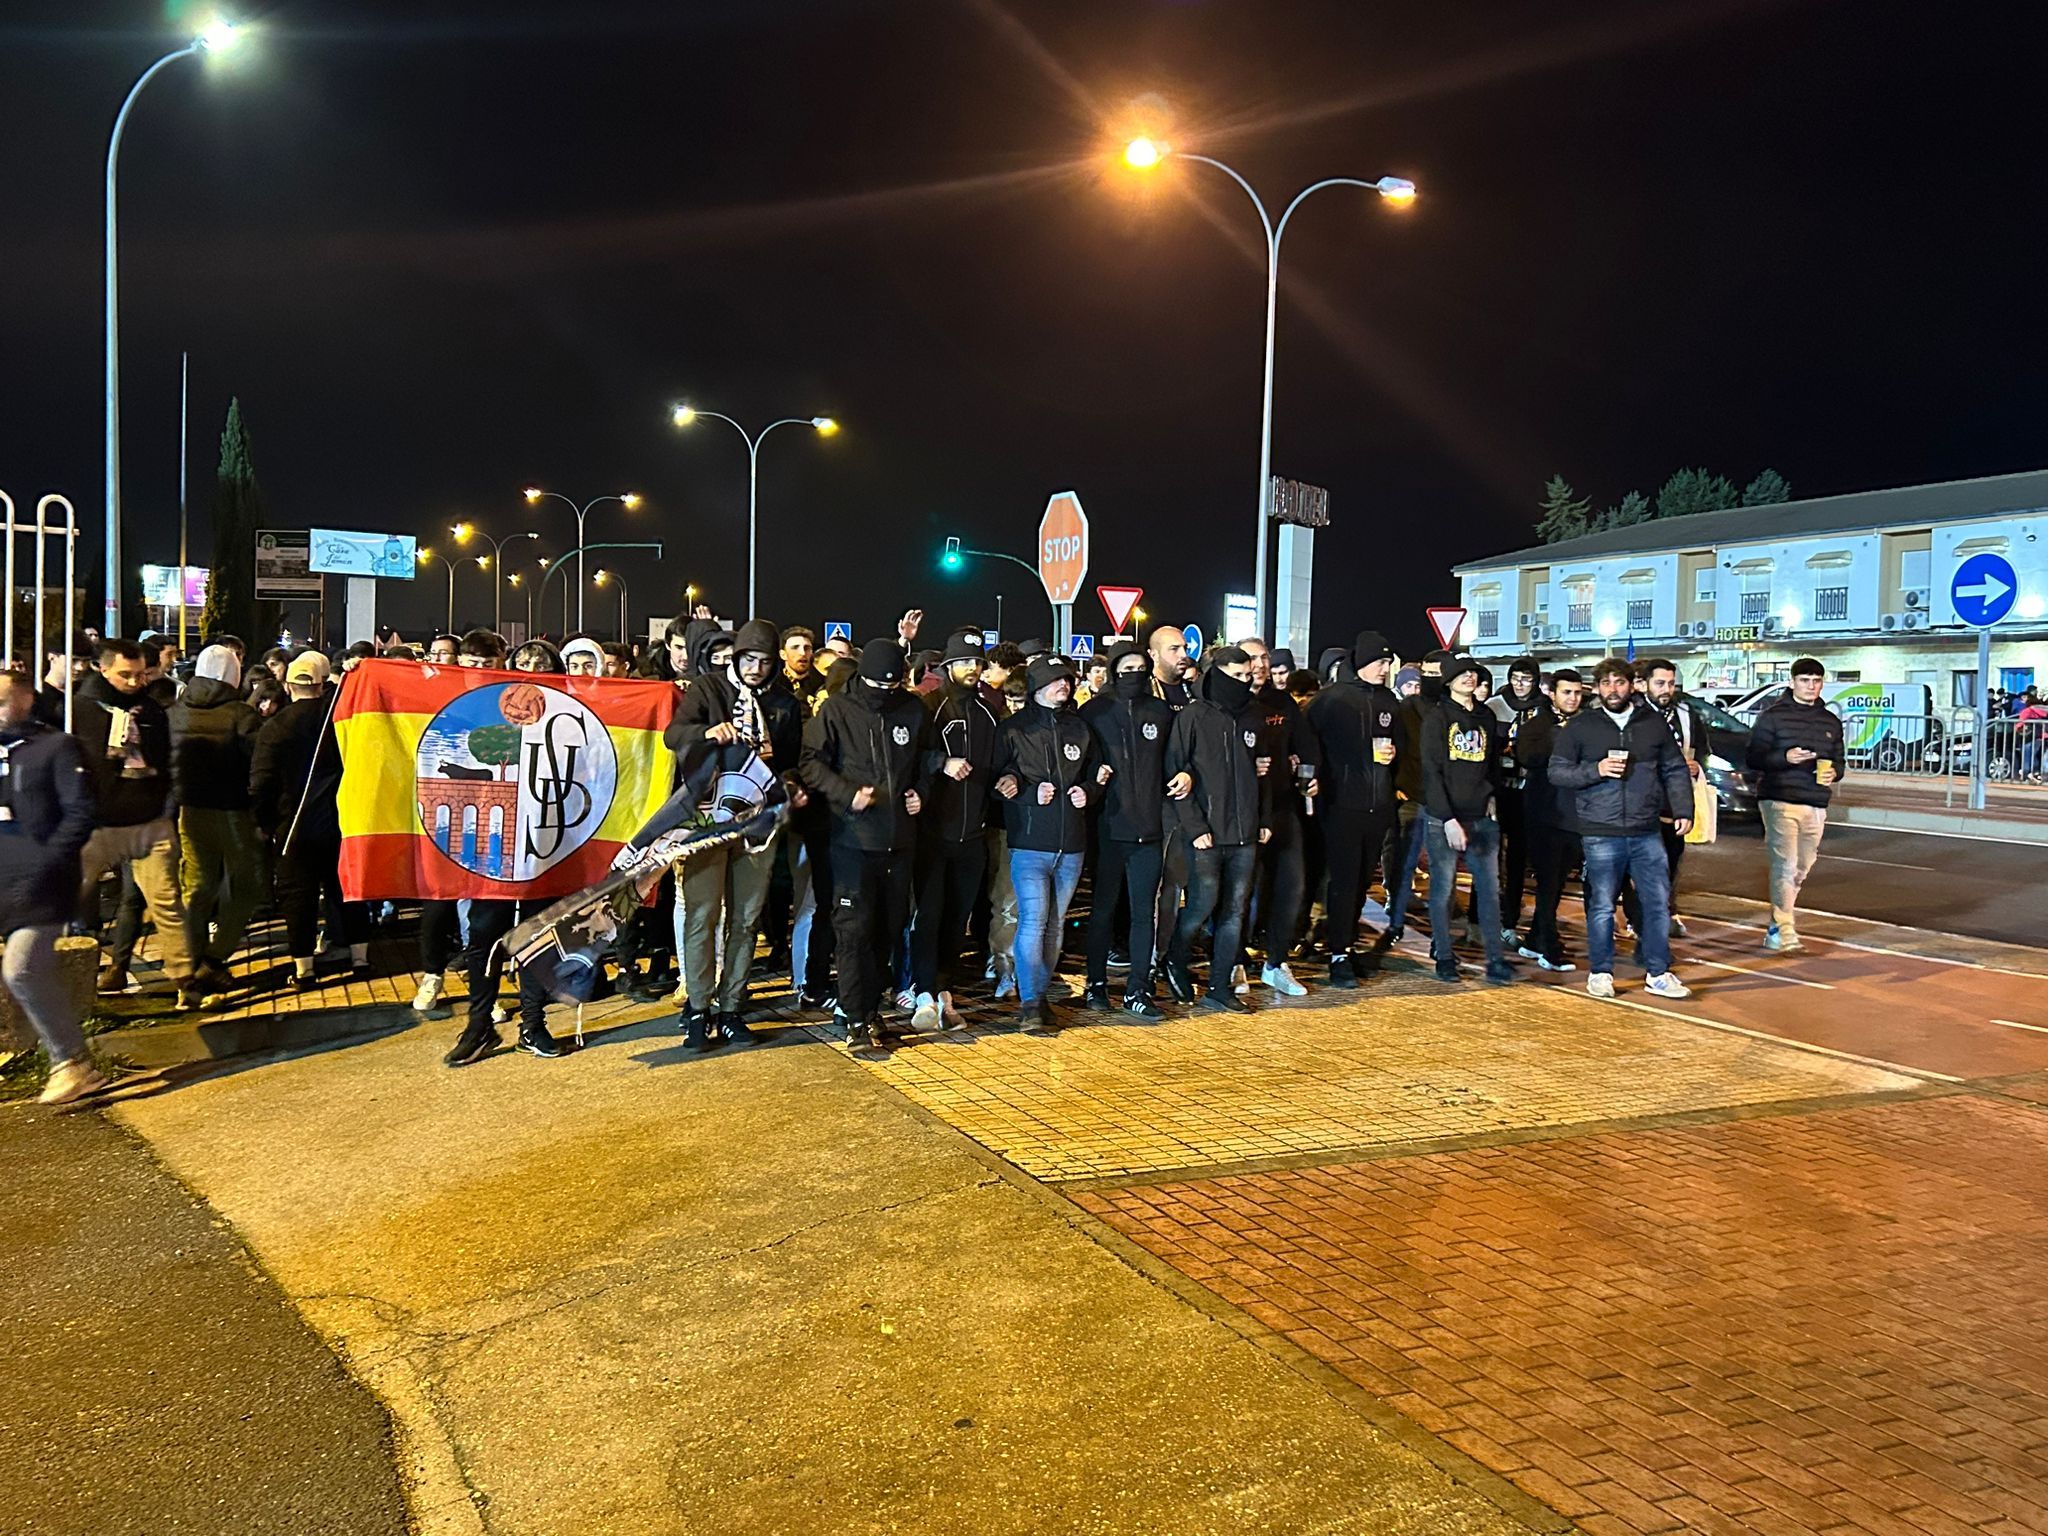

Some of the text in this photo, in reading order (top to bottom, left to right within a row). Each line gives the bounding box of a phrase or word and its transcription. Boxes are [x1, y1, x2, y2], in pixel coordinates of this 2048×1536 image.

[1271, 476, 1331, 526] HOTEL
[1044, 535, 1080, 564] STOP
[1715, 627, 1757, 641] HOTEL
[1847, 692, 1895, 708] acoval
